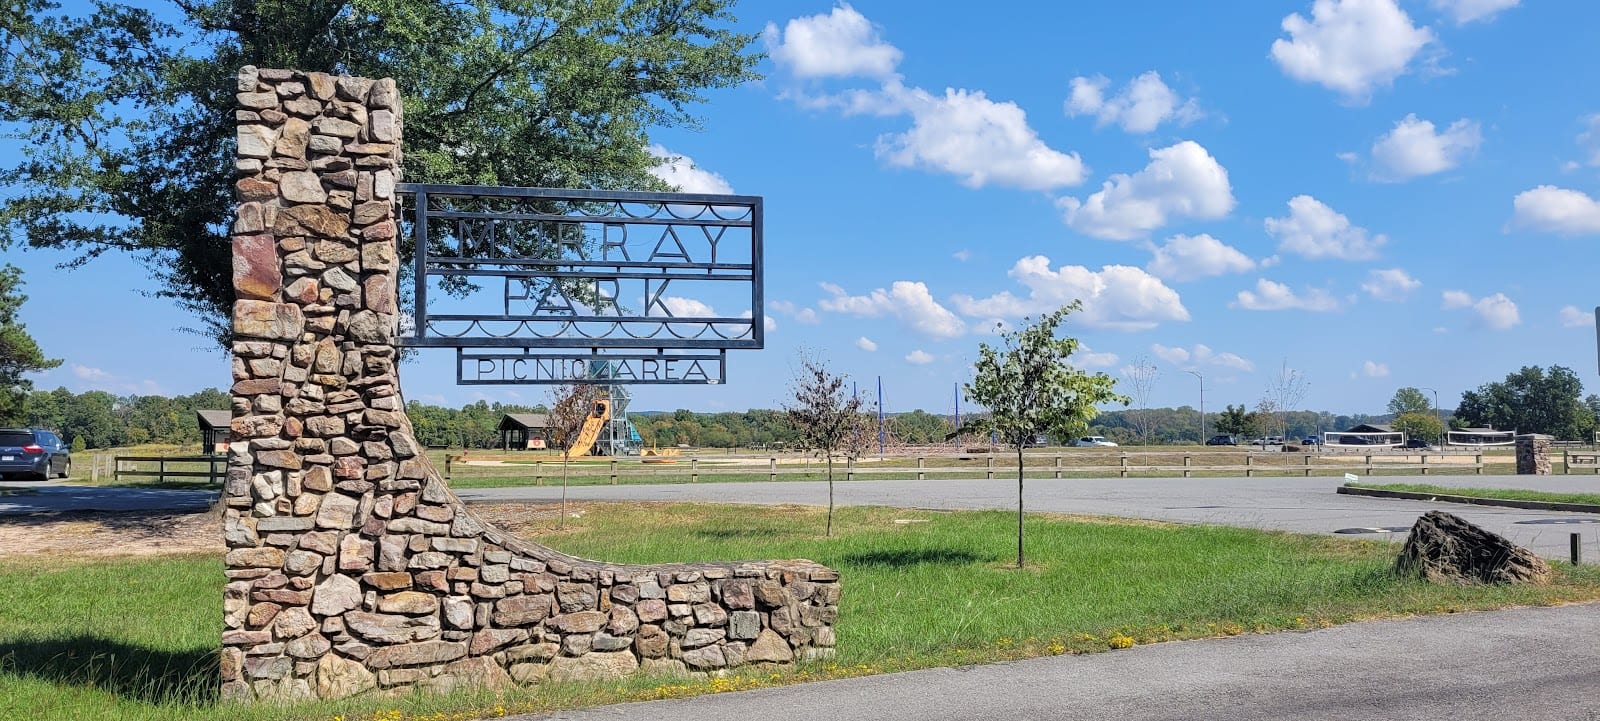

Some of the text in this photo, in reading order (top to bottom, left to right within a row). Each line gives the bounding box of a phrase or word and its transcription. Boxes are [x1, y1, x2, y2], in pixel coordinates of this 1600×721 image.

[459, 220, 728, 263] MURRAY
[505, 277, 674, 317] PARK
[477, 359, 709, 380] PICNIC AREA
